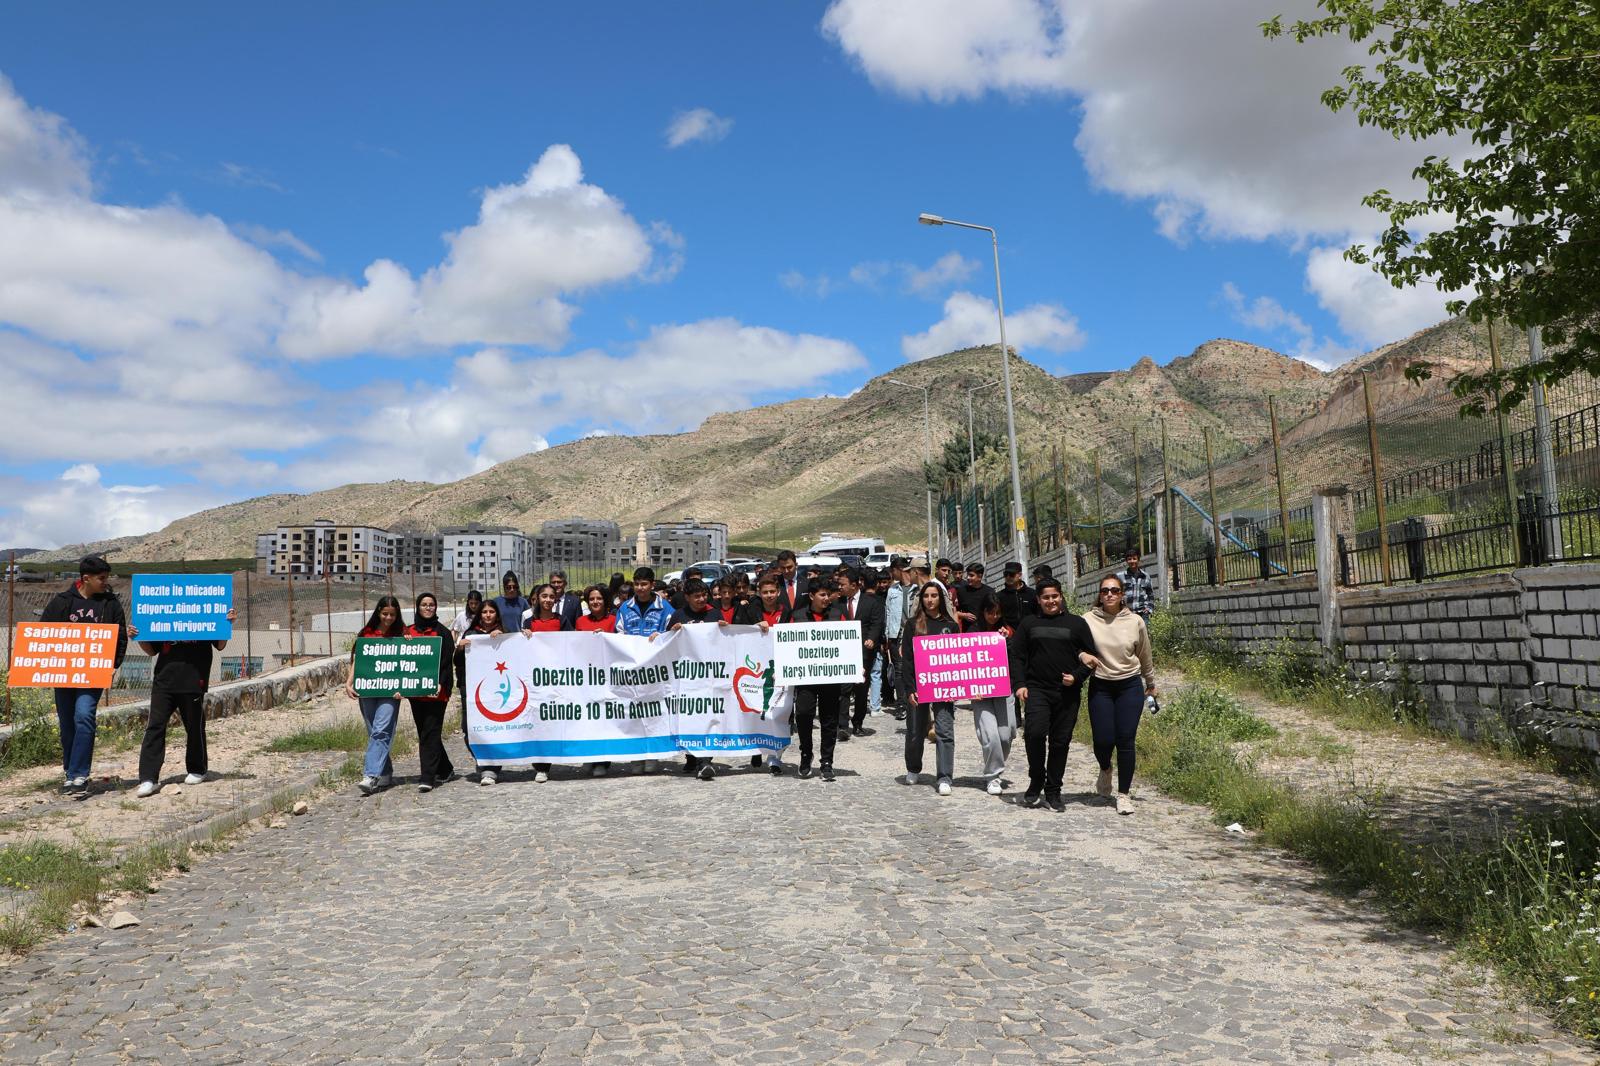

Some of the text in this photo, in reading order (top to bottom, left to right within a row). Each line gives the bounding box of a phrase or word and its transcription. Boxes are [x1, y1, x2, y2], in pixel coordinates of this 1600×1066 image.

[139, 583, 225, 596] Obezite İle Mücadele
[203, 603, 212, 614] 10
[214, 603, 227, 614] Bin
[23, 626, 112, 640] Sağlığın İçin
[150, 620, 216, 633] Adım Yürüyoruz
[777, 628, 860, 643] Kalbimi Seviyorum.
[28, 641, 103, 654] Hareket Et
[362, 643, 434, 656] Sağlıklı Beslen,
[920, 635, 999, 651] Yediklerine
[798, 646, 839, 659] Obeziteye
[929, 650, 994, 666] Dikkat Et.
[14, 656, 112, 668] Hergün 10 Bin
[375, 660, 418, 674] Spor Yap,
[31, 671, 90, 684] Adım At.
[532, 659, 730, 687] Obezite İle Mücadele Ediyoruz.
[782, 663, 856, 679] Karşı Yürüyorum
[918, 665, 1008, 687] Şişmanlıktan
[355, 677, 437, 690] Obeziteye Dur De.
[933, 684, 996, 699] Uzak Dur
[539, 694, 725, 721] Günde 10 Bin Adım Yürüyoruz
[713, 737, 736, 749] Sağlık
